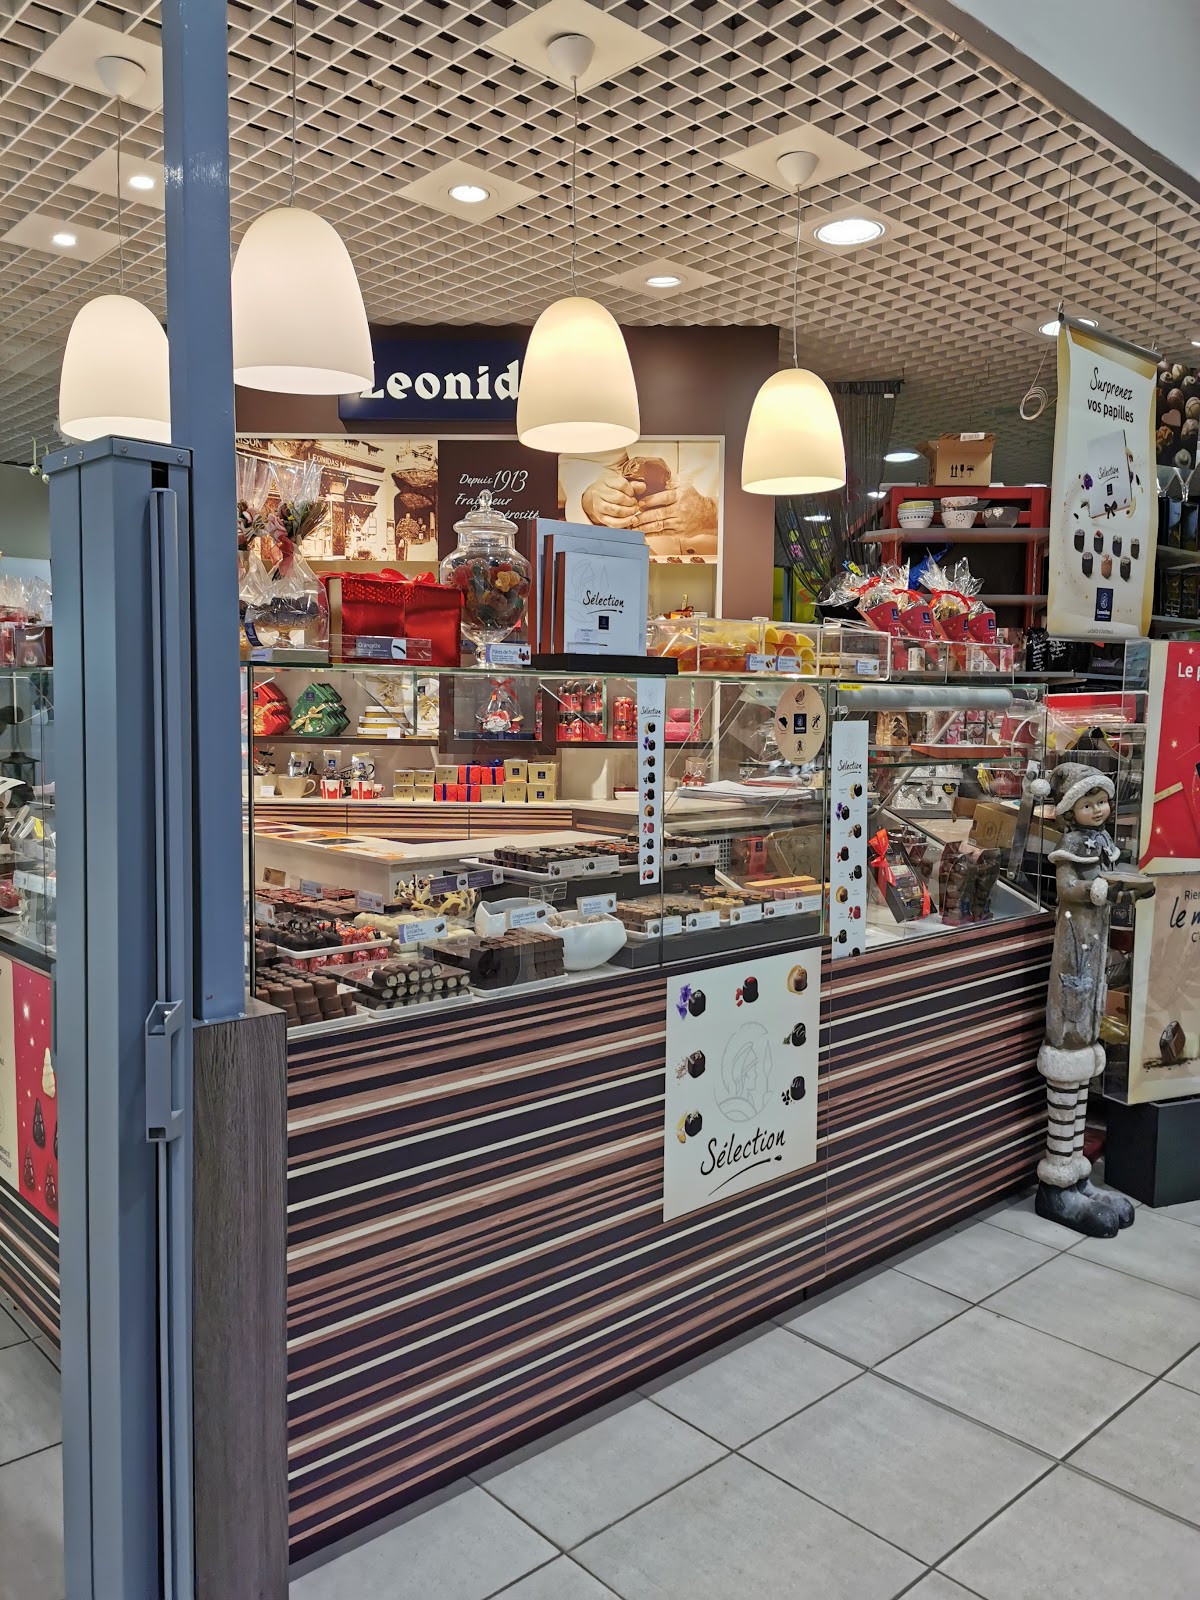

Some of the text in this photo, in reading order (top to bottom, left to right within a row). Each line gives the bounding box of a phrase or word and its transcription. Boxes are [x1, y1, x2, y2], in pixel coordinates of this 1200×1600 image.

[360, 359, 519, 401] eonid
[1090, 366, 1133, 401] Surprenez
[1087, 398, 1134, 424] vos papilles
[459, 469, 529, 493] Depuis 1913
[582, 589, 625, 608] Sélection
[1178, 661, 1194, 678] Le
[1169, 896, 1187, 928] le
[700, 1127, 786, 1175] Sélection
